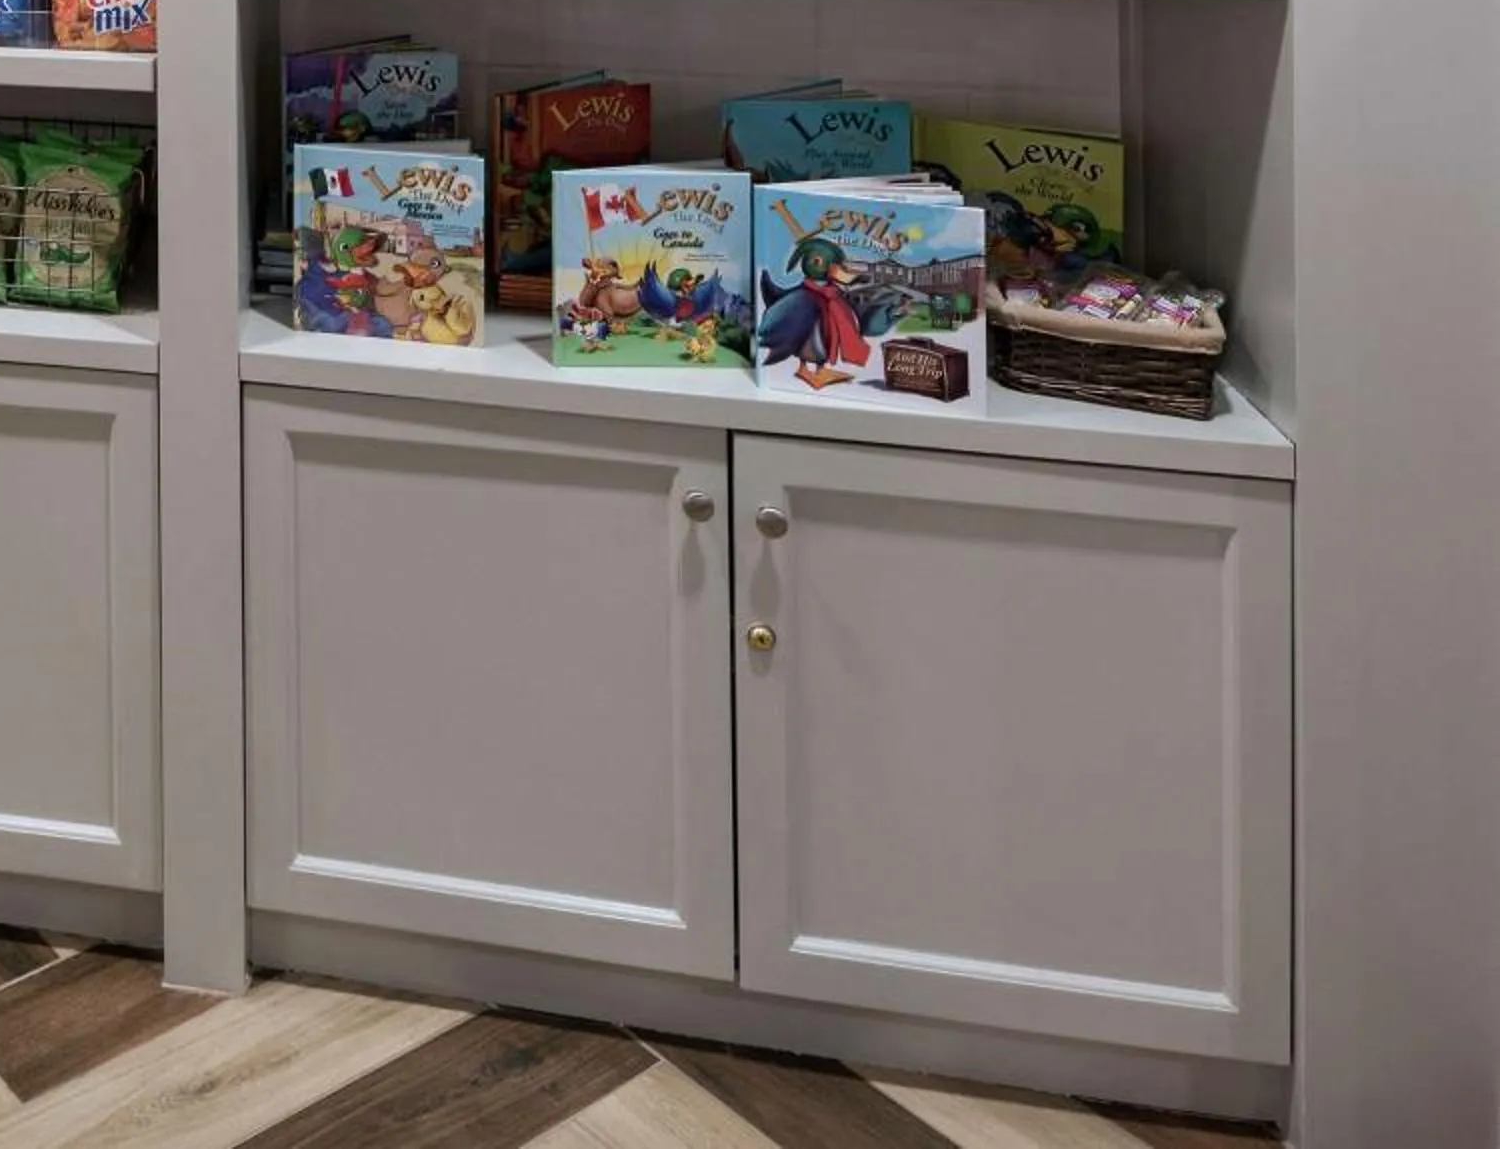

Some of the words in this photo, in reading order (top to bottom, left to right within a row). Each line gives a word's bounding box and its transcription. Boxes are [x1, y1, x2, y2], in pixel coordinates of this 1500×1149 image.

[350, 59, 442, 98] Lewis
[549, 92, 635, 132] Lewis
[784, 107, 894, 145] Lewis
[985, 138, 1104, 183] Lewis
[361, 163, 473, 203] Lewis
[624, 183, 735, 227] Lewis
[769, 198, 909, 252] Lewis
